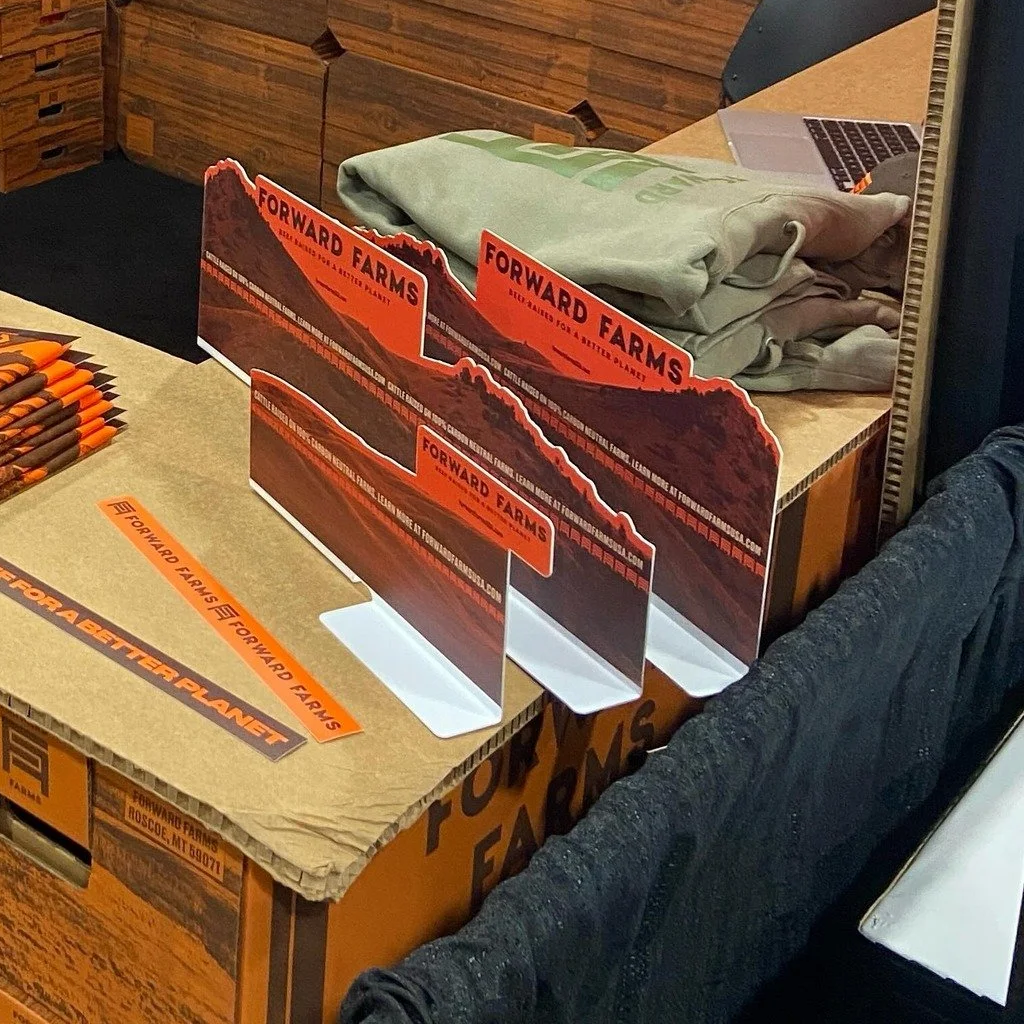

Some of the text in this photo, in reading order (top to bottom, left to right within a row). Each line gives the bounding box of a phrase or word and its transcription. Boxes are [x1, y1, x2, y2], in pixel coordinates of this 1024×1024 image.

[258, 187, 343, 257] FORWARD
[352, 245, 419, 307] FARMS
[484, 241, 589, 325] FORWARD
[597, 314, 683, 386] FARMS
[556, 319, 571, 333] FOR
[581, 336, 611, 361] BETTER
[614, 357, 647, 382] PLANET
[311, 437, 332, 462] CARBON
[332, 455, 356, 482] NEUTRAL
[377, 493, 396, 515] LEARN
[396, 508, 414, 529] MORE
[413, 523, 421, 536] AT
[387, 381, 406, 400] CATTLE
[405, 394, 423, 413] RAISED
[447, 424, 469, 446] CARBON
[469, 439, 493, 464] NEUTRAL
[516, 473, 535, 492] LEARN
[536, 487, 552, 506] MORE
[552, 499, 561, 511] AT
[504, 367, 521, 387] CATTLE
[521, 380, 540, 400] RAISED
[563, 410, 585, 432] CARBON
[584, 425, 609, 451] NEUTRAL
[631, 458, 651, 479] LEARN
[651, 472, 669, 492] MORE
[668, 485, 678, 498] AT
[422, 436, 489, 498] FORWARD
[496, 492, 547, 543] FARMS
[11, 578, 63, 613] FOR
[54, 609, 79, 626] A
[77, 619, 180, 684] BETTER
[175, 677, 290, 748] PLANET
[125, 515, 341, 732] FORWARD FARMS FORWARD FARMS
[9, 778, 42, 805] FARMS
[128, 805, 221, 875] ROSCOE, MT 59071
[133, 789, 219, 853] FORWARD FARMS
